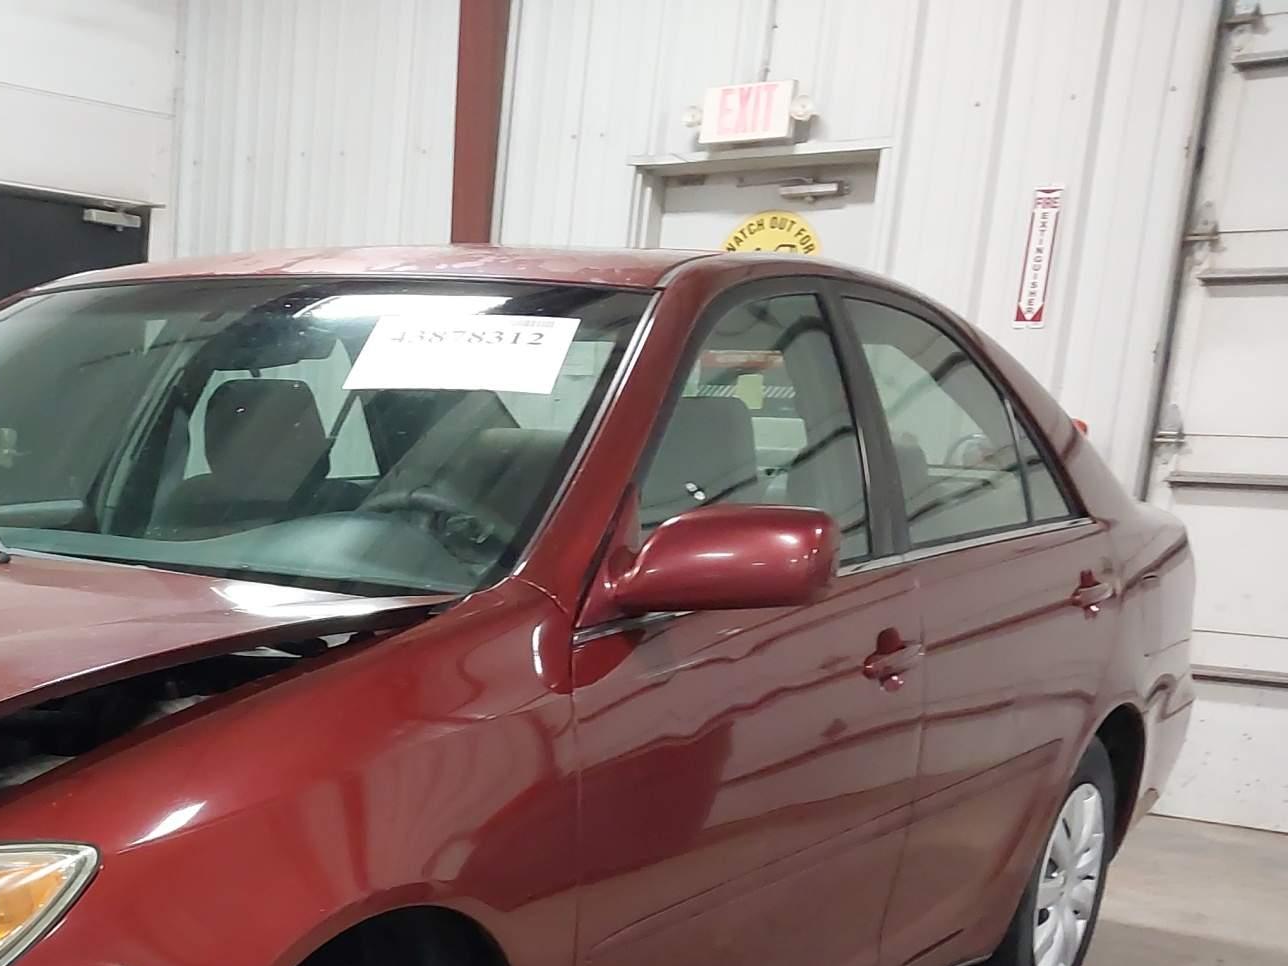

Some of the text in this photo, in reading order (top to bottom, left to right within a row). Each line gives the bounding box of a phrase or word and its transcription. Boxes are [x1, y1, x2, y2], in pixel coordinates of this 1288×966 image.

[716, 83, 778, 136] EXIT
[1034, 196, 1060, 209] FIRE
[769, 216, 797, 232] OUT
[794, 227, 815, 255] FOR
[1025, 211, 1049, 314] EXTINGUISHER
